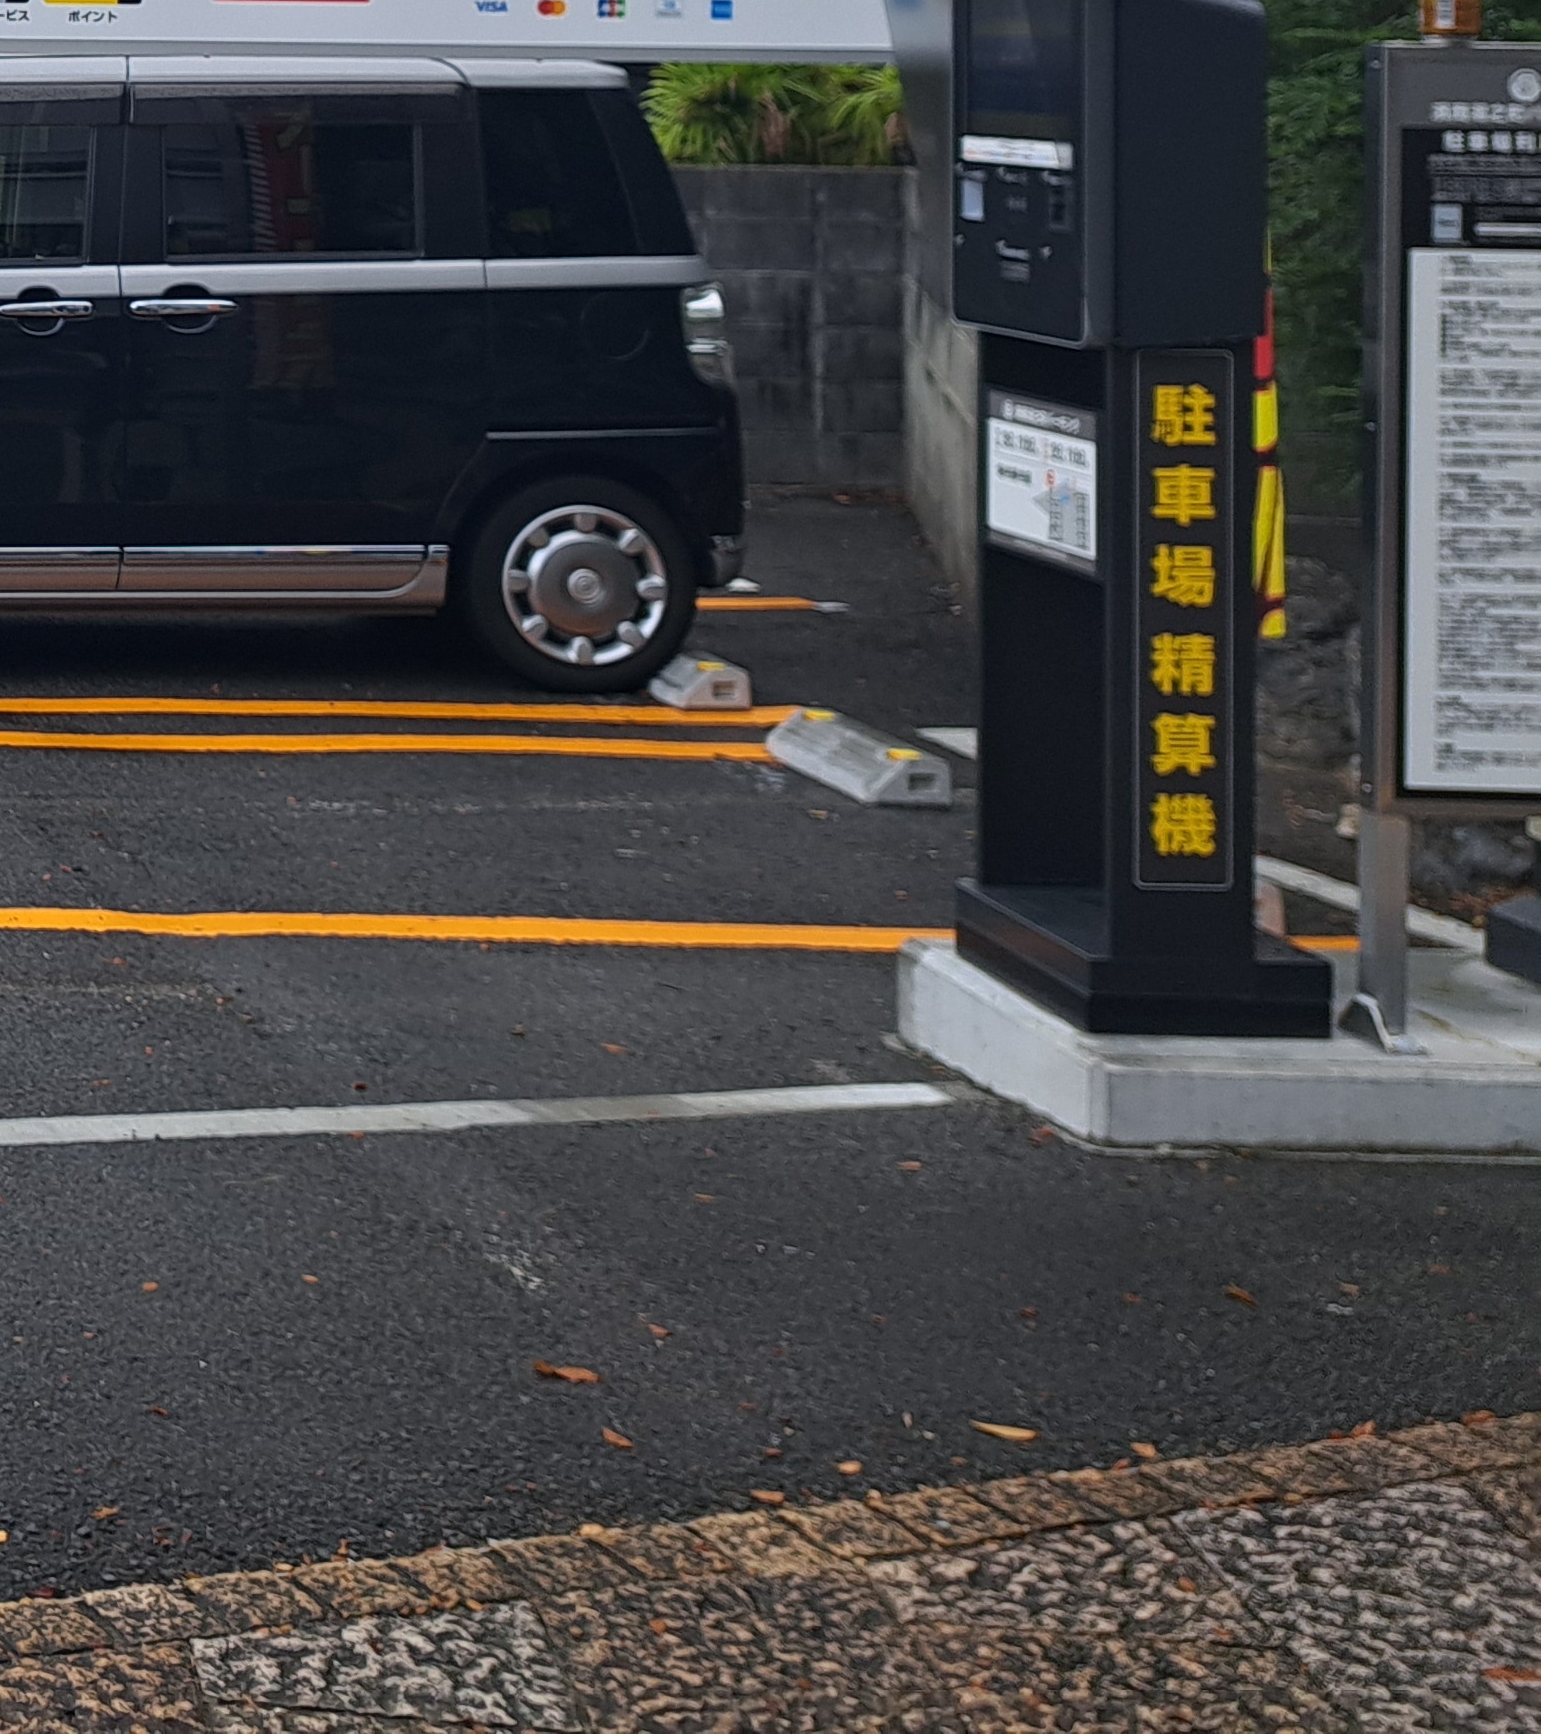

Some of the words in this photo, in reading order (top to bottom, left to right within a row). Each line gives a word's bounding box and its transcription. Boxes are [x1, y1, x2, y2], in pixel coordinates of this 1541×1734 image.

[474, 0, 509, 13] VISA
[68, 10, 119, 23] ポイント
[1150, 383, 1217, 858] 駐車場精算機
